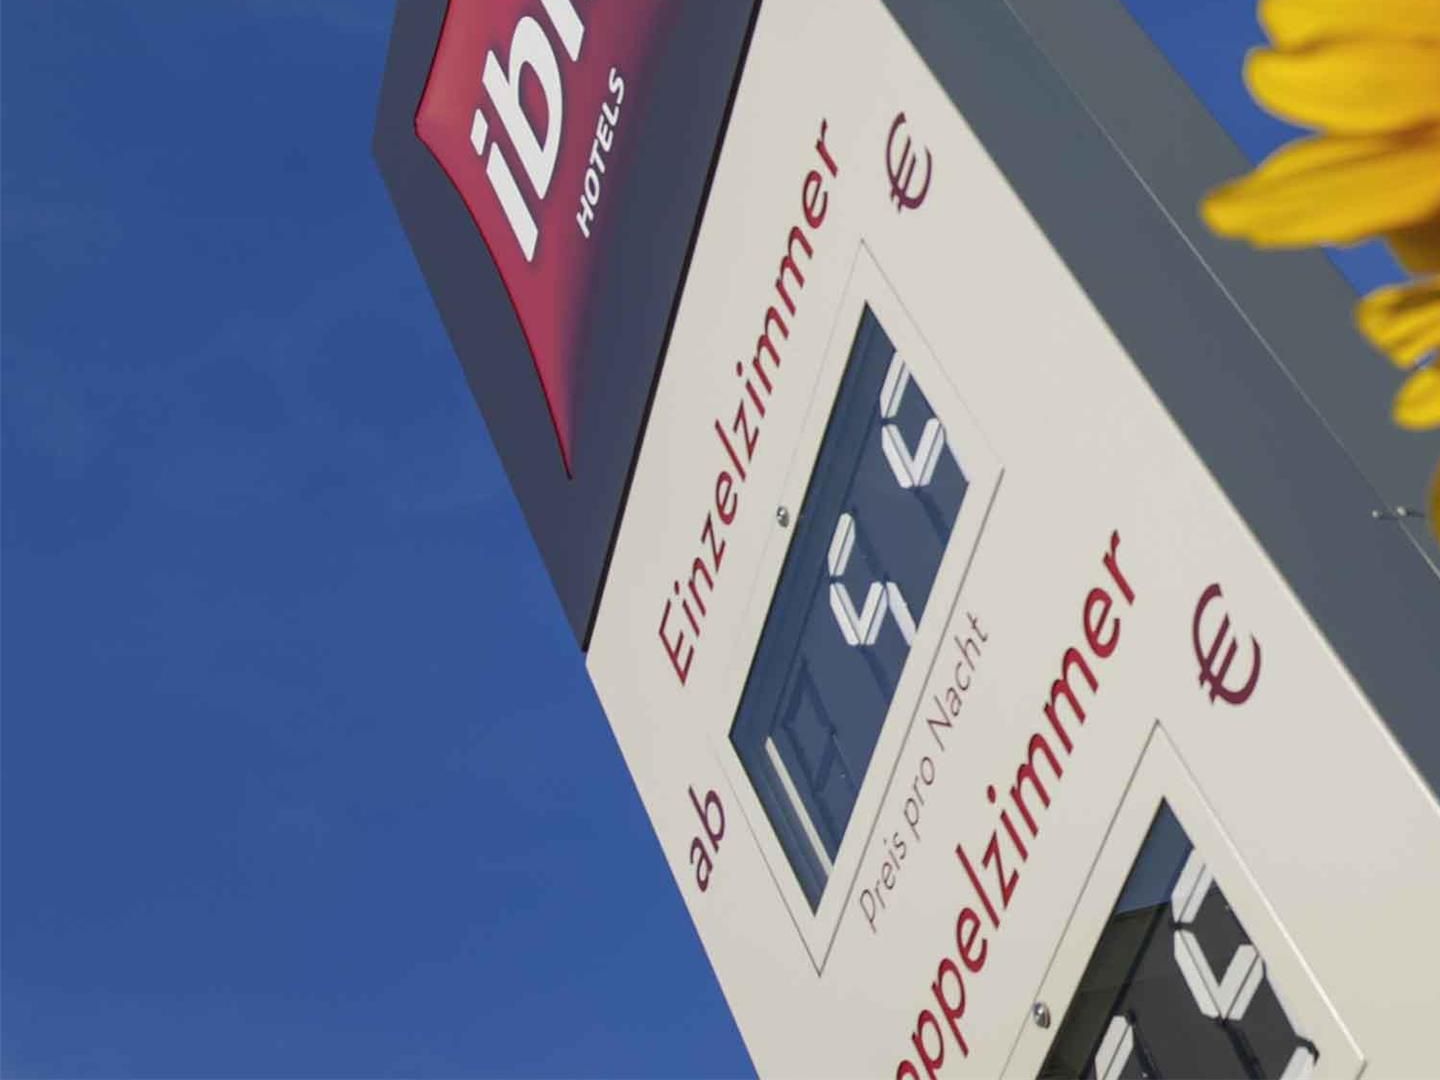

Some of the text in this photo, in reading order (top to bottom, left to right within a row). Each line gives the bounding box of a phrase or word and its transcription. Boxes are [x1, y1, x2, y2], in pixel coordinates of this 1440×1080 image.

[576, 67, 625, 239] HOTELS
[658, 118, 838, 687] Einzelzimmer
[688, 786, 728, 895] ab
[859, 611, 990, 934] Preis pro Nacht
